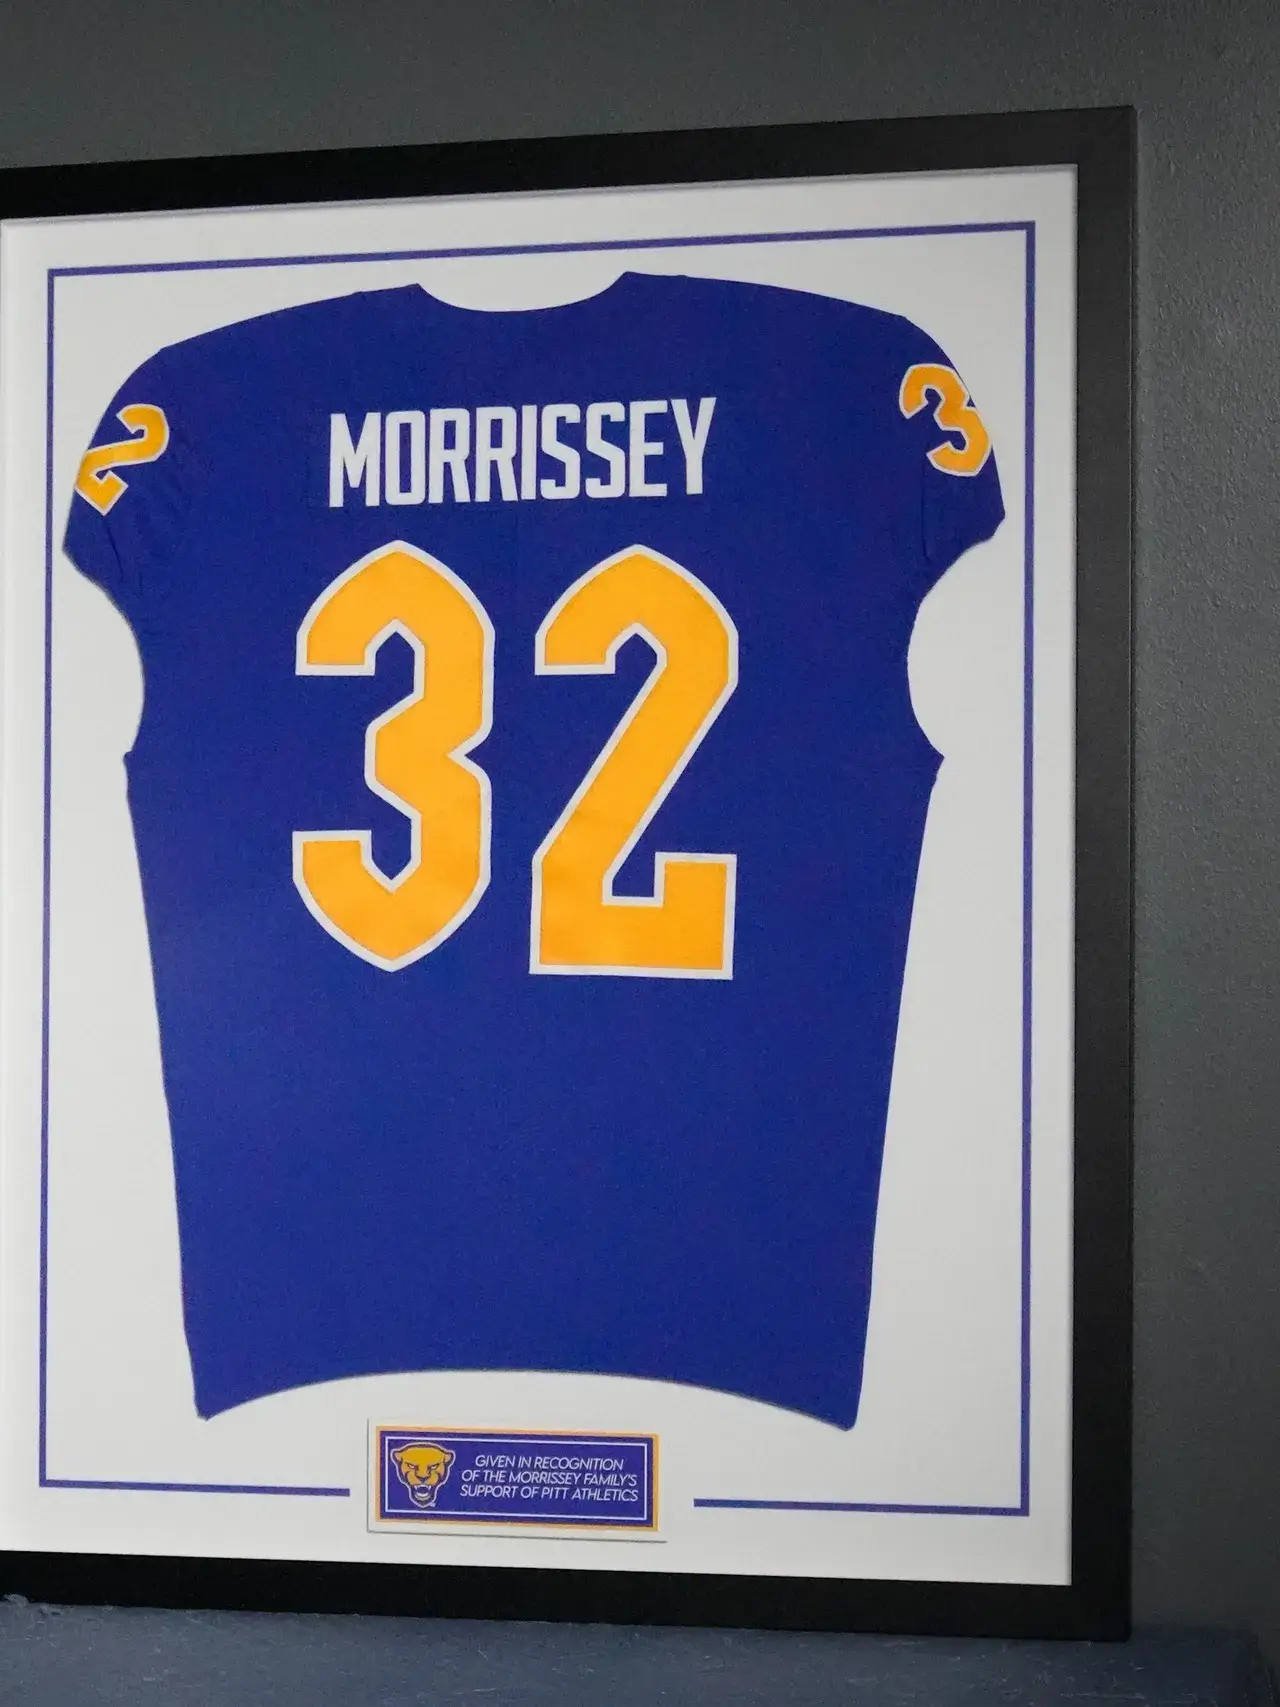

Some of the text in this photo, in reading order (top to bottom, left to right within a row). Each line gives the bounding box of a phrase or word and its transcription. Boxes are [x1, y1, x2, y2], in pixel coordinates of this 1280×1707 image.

[73, 403, 170, 517] 2
[328, 397, 717, 508] MORRISSEY
[898, 362, 991, 477] 3
[292, 539, 738, 979] 32
[460, 1485, 639, 1502] SUPPORT OF PITT ATHLETICS
[462, 1470, 637, 1487] OF THE MORRISSEY FAMILY'S
[475, 1455, 624, 1471] GIVEN IN RECOGNITION
